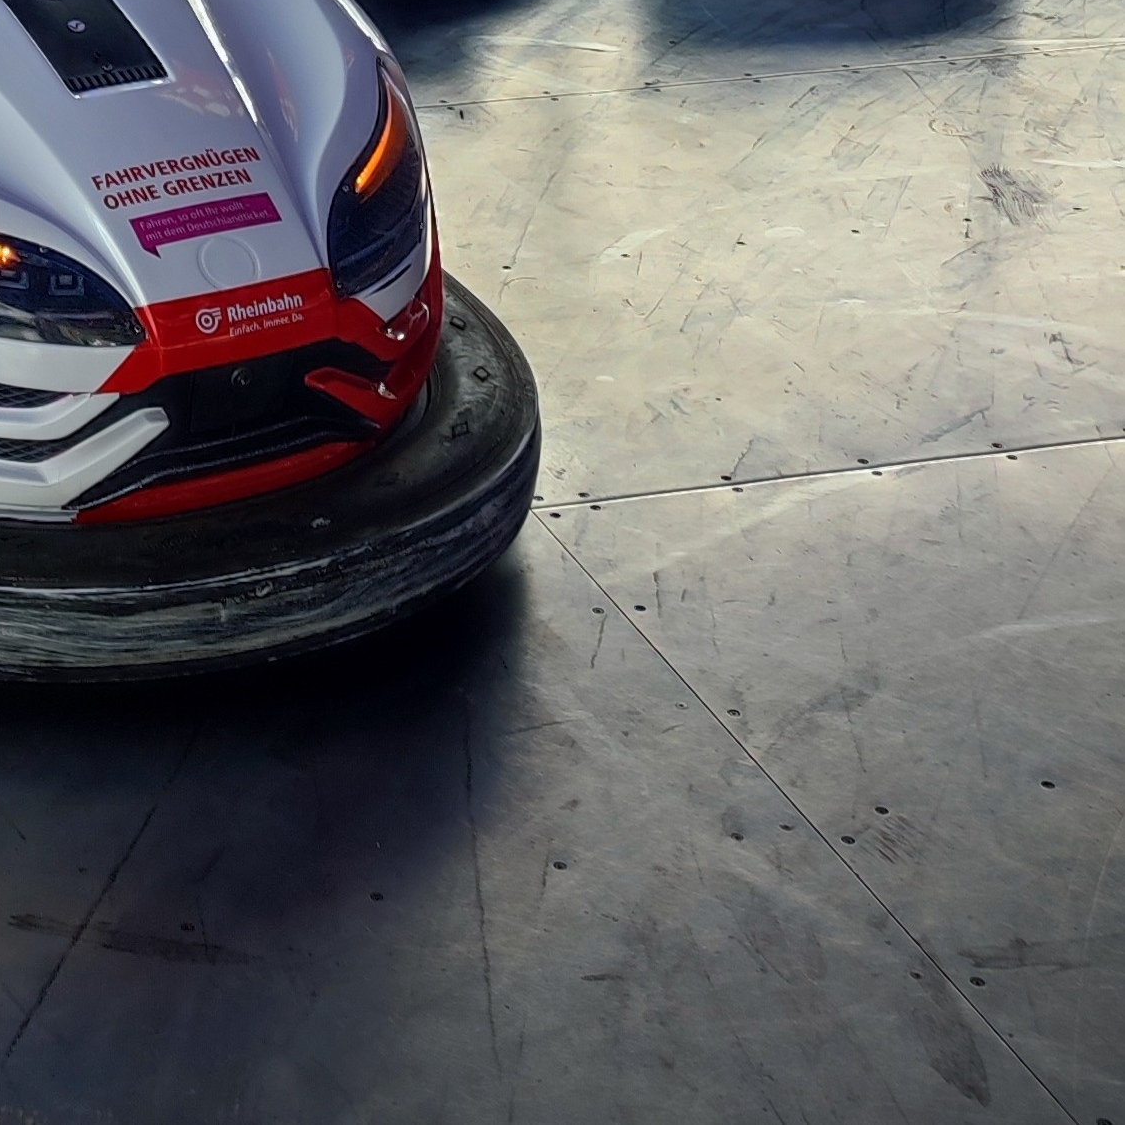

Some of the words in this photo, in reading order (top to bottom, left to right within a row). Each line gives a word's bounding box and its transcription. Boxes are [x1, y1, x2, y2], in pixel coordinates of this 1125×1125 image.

[91, 146, 262, 191] FAHRVERGNÜGEN
[103, 184, 161, 210] OHNE
[162, 167, 252, 196] GRENZEN
[145, 229, 163, 242] mit
[226, 292, 303, 323] Rheinbahn
[229, 321, 262, 337] Einfach.
